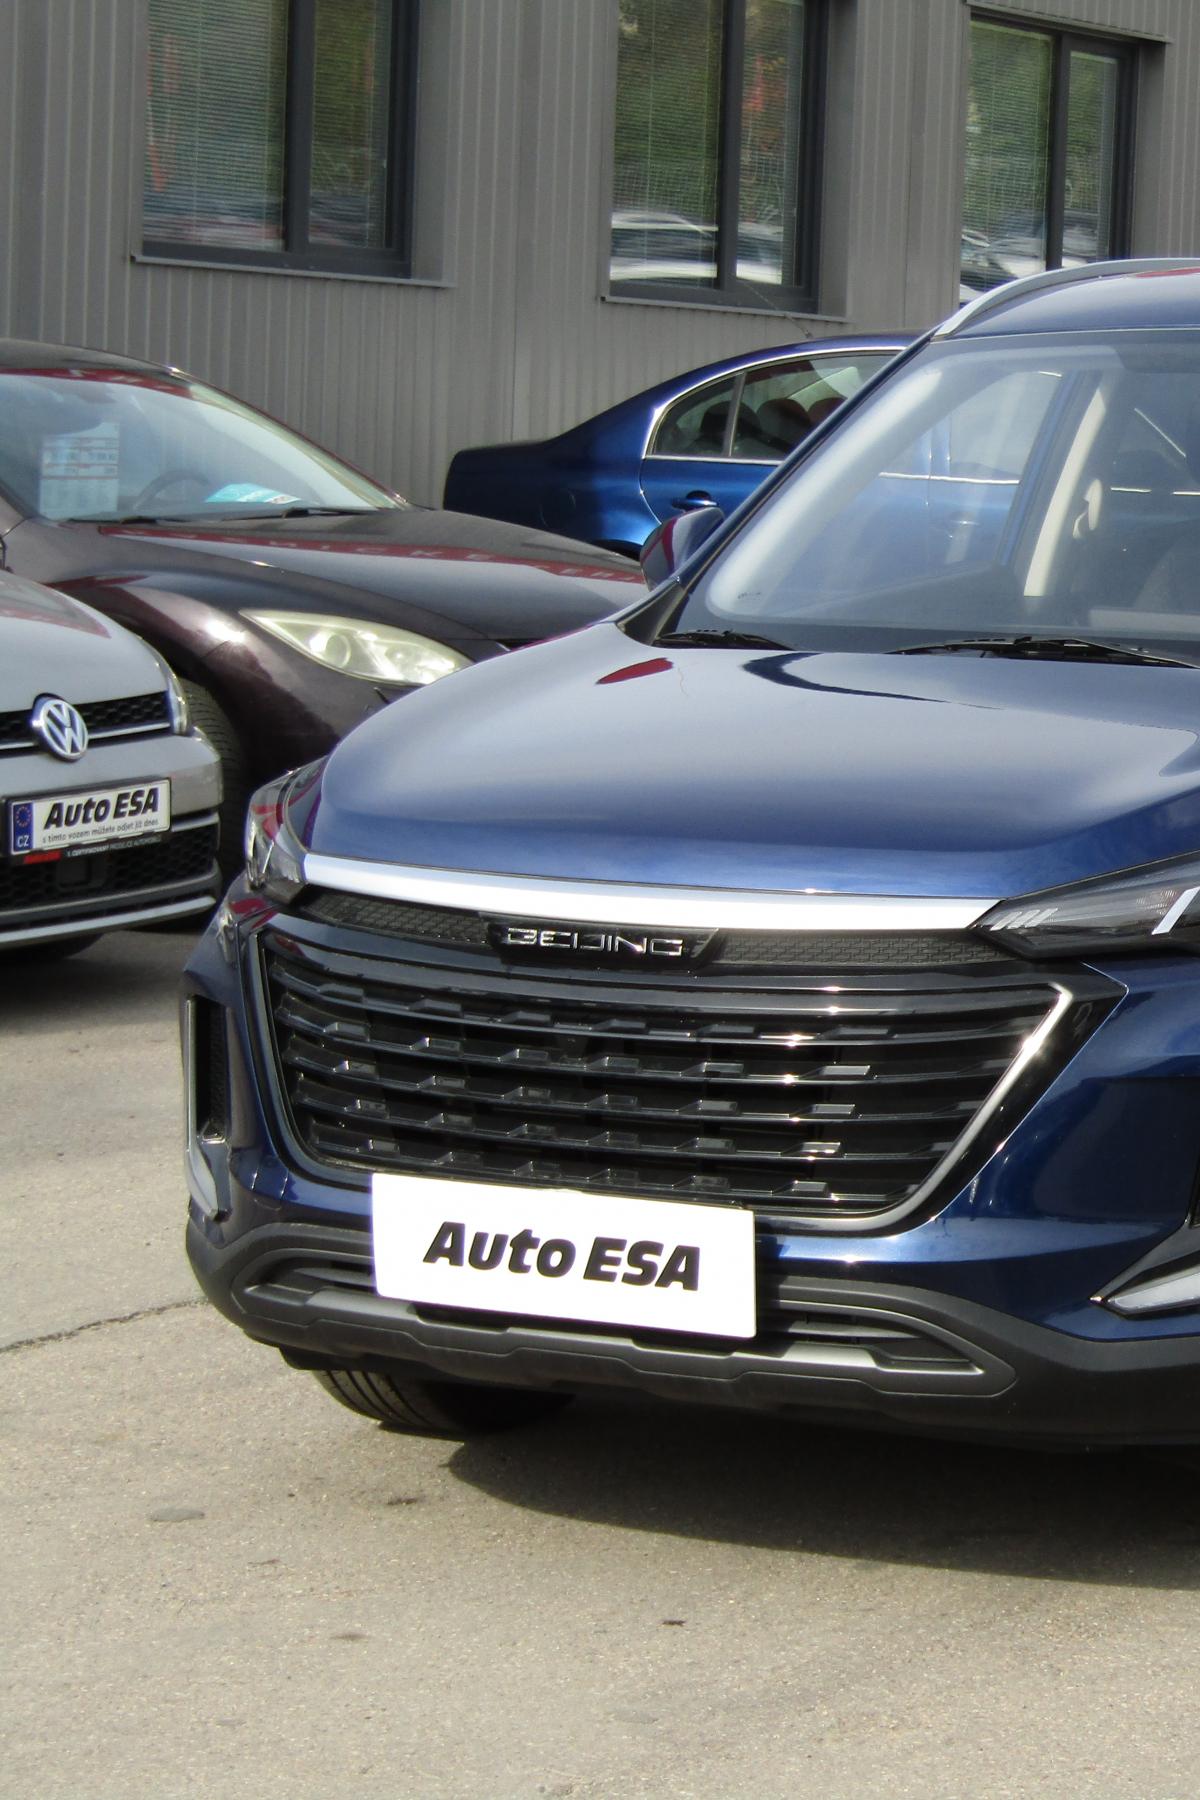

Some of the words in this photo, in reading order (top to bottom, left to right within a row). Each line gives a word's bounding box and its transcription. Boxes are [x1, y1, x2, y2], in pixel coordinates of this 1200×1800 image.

[43, 798, 111, 830] Auto
[113, 787, 159, 819] ESA
[17, 835, 30, 848] CZ
[508, 927, 683, 957] BEIJING
[423, 1221, 577, 1279] Auto
[583, 1236, 701, 1292] ESA
